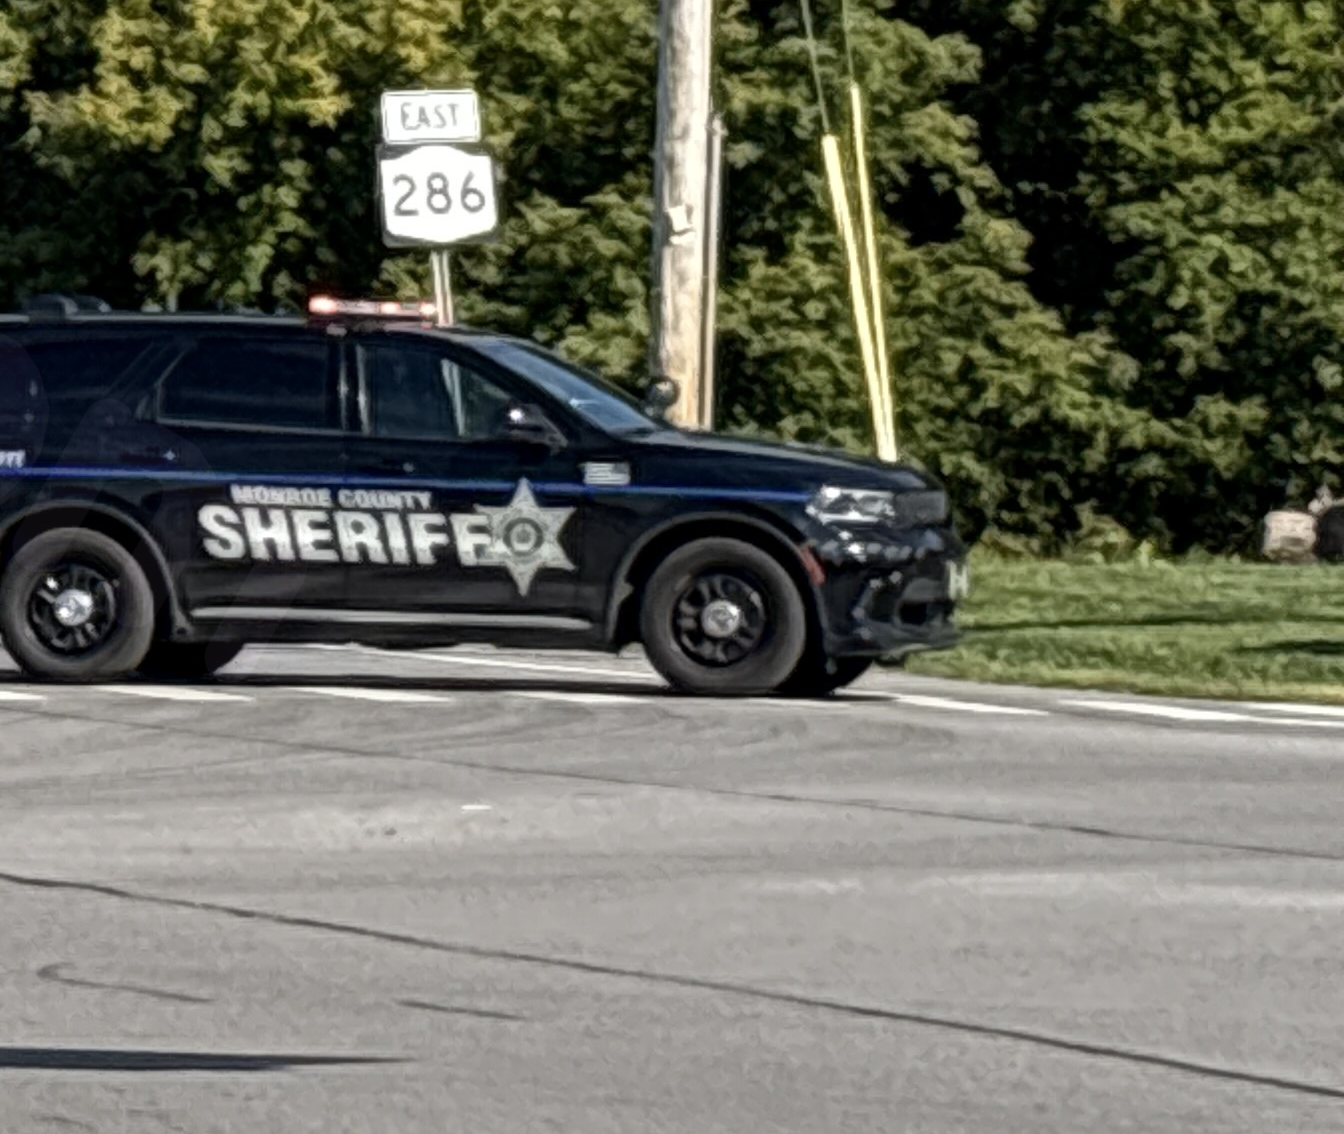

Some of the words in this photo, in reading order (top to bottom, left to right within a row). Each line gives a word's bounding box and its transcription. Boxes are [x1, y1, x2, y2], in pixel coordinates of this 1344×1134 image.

[401, 102, 459, 130] EAST
[393, 170, 486, 216] 286
[230, 484, 332, 508] MONROE
[338, 488, 433, 510] COUNTY
[198, 504, 492, 566] SHERIFF
